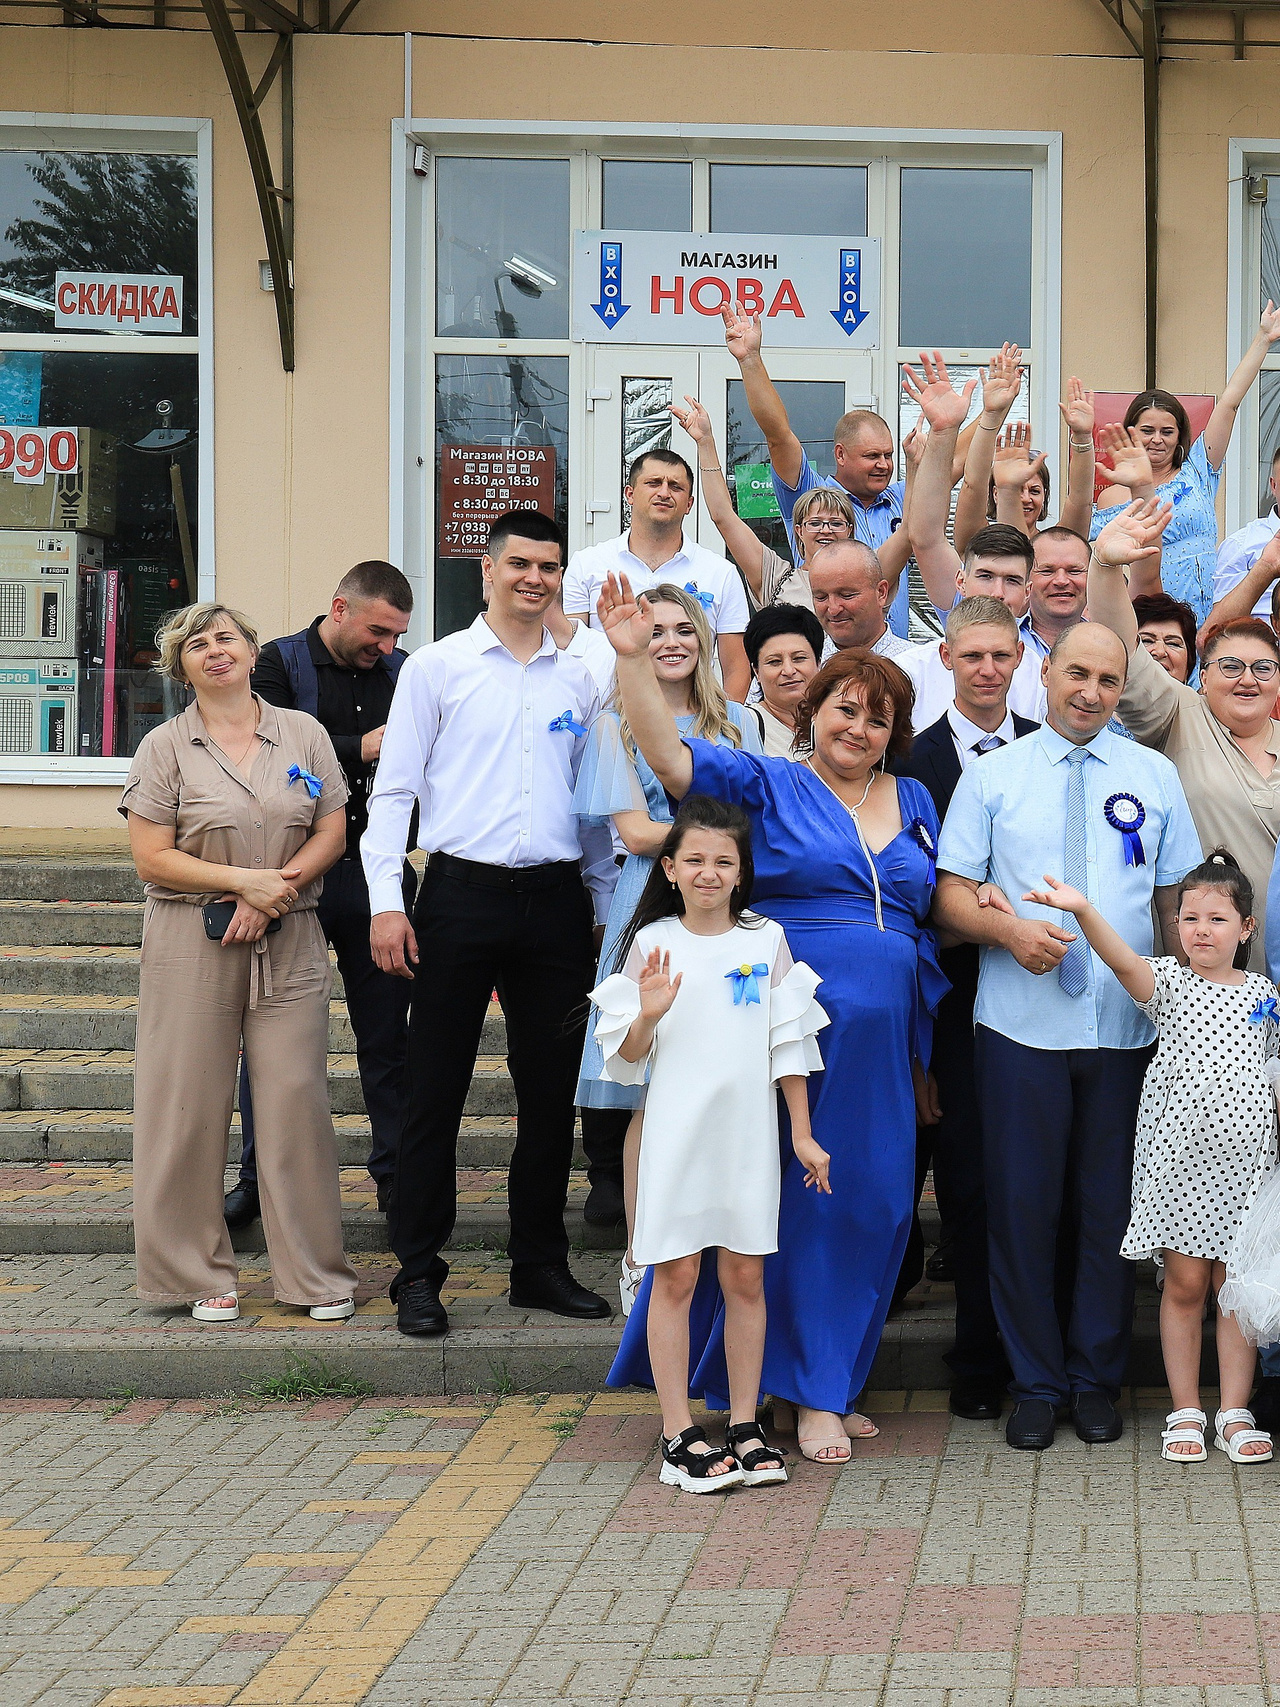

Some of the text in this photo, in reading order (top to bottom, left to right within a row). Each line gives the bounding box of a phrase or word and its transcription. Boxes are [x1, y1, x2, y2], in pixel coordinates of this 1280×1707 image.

[680, 251, 778, 270] МАГАЗИН
[603, 248, 618, 318] ВХОД
[843, 254, 857, 324] ВХОД
[57, 281, 180, 323] СКИДКА
[650, 275, 806, 318] НОВА
[450, 448, 546, 461] Магазин НОВА
[453, 475, 539, 487] с 8:30 до 18:30
[751, 480, 773, 489] Отк
[453, 499, 539, 511] с 8:30 до 17:00
[452, 511, 464, 519] без
[444, 522, 491, 534] +7 (938)
[445, 534, 459, 544] +7
[138, 564, 159, 574] oasis
